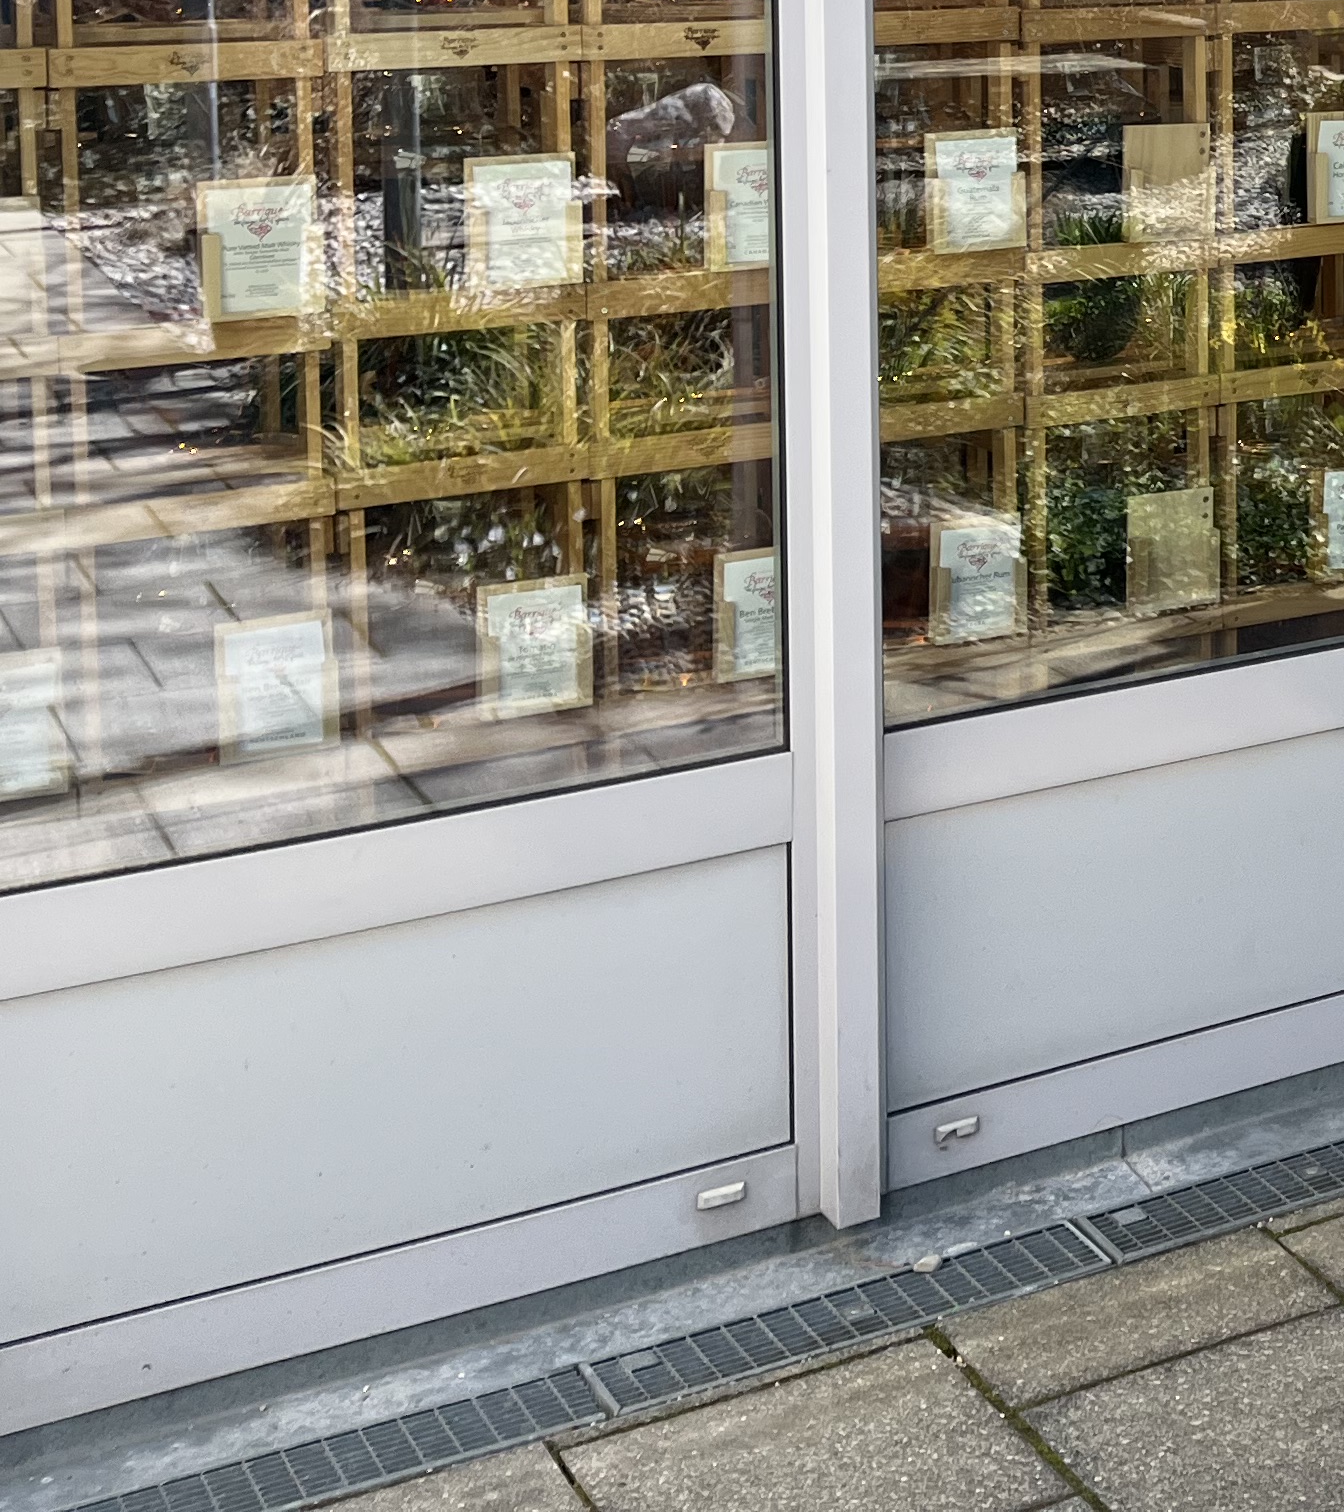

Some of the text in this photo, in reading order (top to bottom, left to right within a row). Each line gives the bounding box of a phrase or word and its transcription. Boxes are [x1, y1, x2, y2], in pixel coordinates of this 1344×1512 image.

[729, 199, 762, 208] Canadian
[952, 571, 1011, 583] ubanischer Rum
[739, 608, 756, 619] Ben
